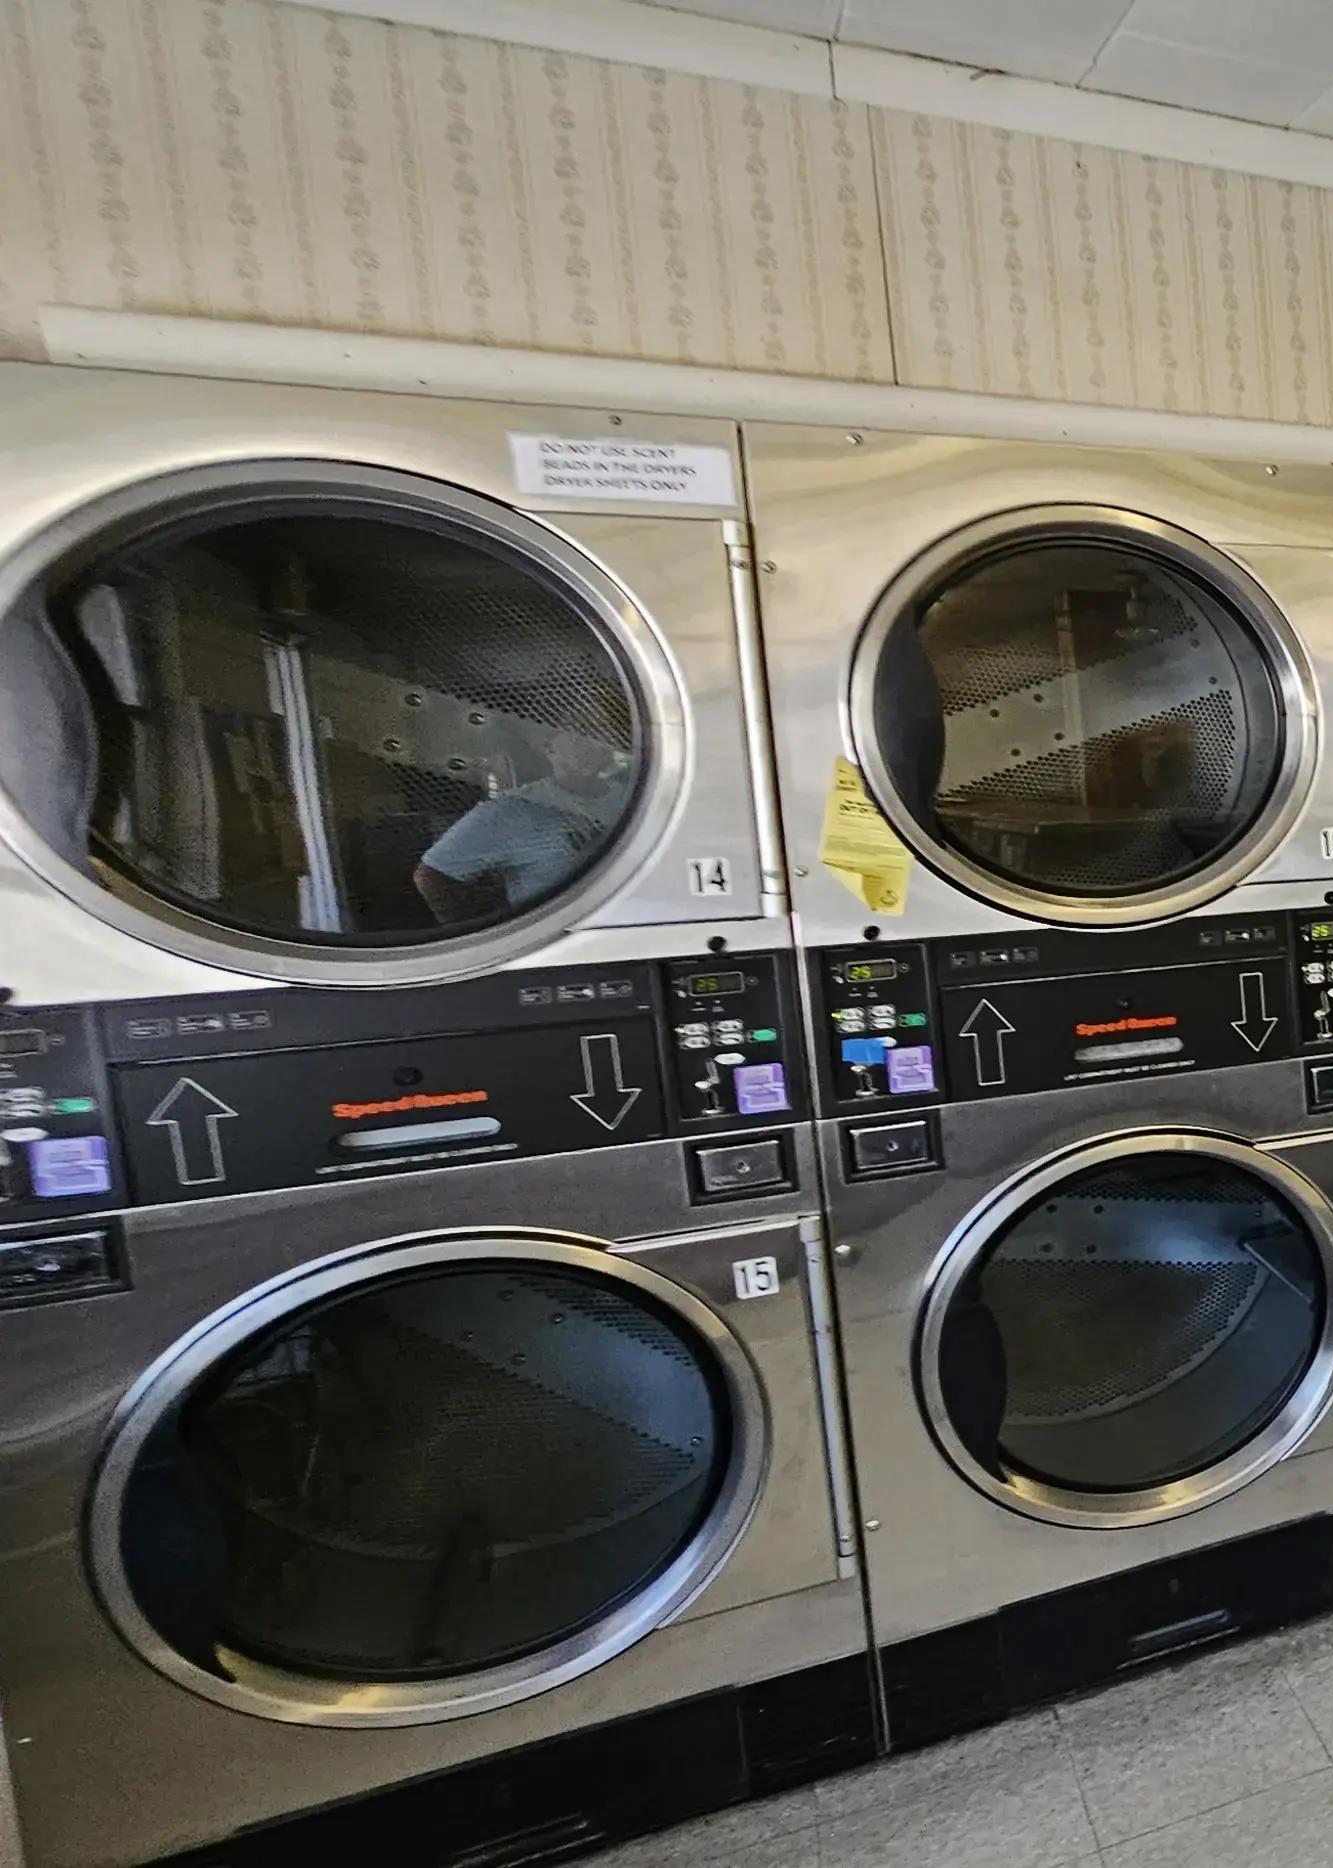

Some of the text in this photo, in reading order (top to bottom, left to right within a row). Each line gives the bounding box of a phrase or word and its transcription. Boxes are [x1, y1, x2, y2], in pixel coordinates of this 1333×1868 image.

[540, 441, 676, 459] DO NOT USE SCENT
[543, 459, 697, 476] BEADS IN THE DRYERS
[544, 474, 688, 492] DRYER SHEETS ONLY
[693, 859, 726, 892] 14
[739, 1263, 775, 1293] 15
